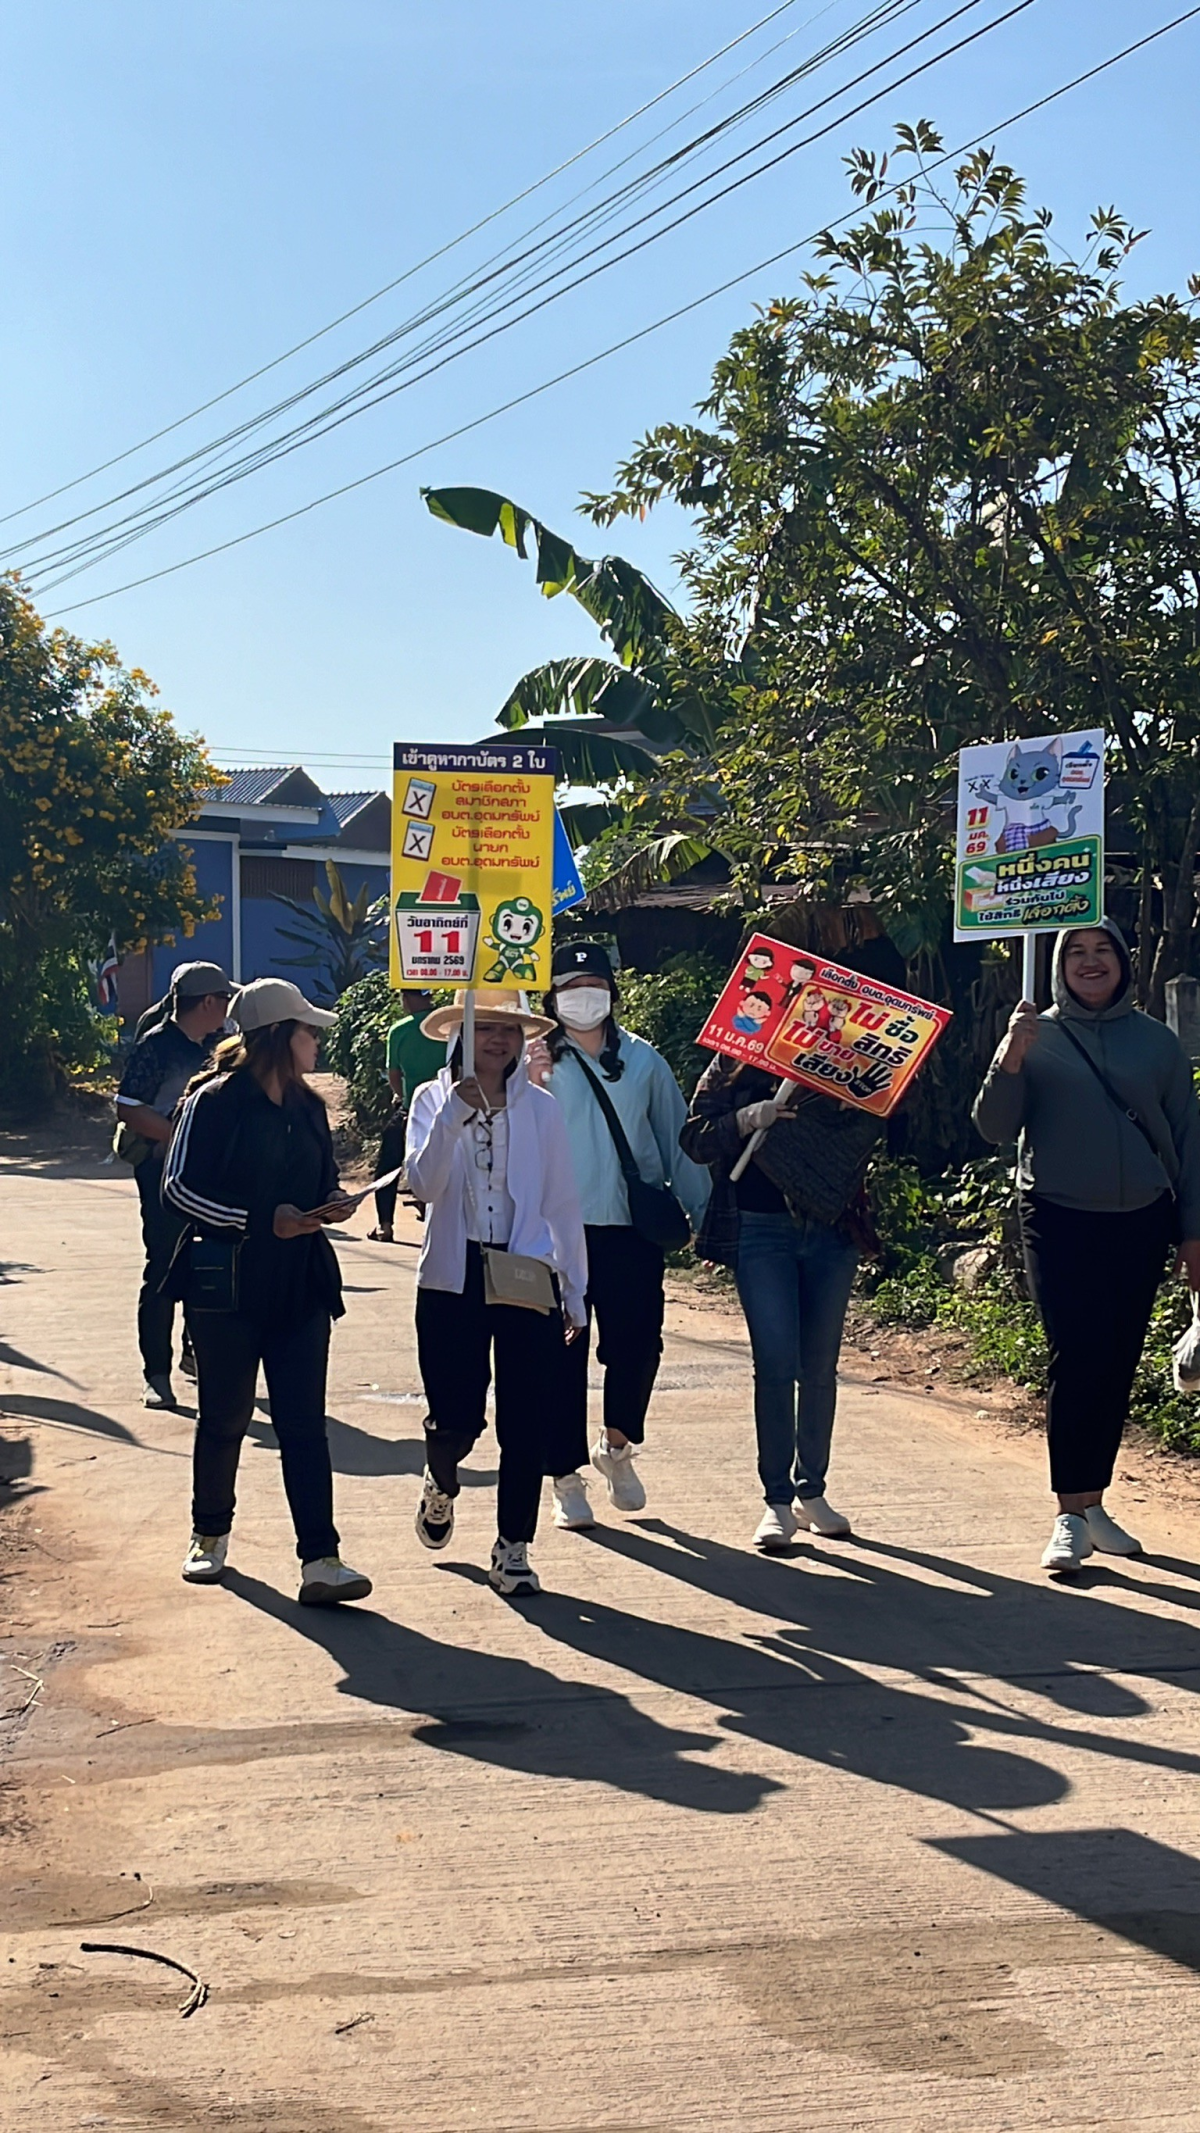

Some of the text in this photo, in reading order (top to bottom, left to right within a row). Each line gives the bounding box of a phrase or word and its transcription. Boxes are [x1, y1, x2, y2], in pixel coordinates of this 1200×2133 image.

[402, 749, 546, 770] เข้าคูหากาบัตร 2 ใบ
[452, 778, 530, 794] บัตรเลือกตั้ง
[455, 795, 526, 807] สมาชิกสภา
[442, 810, 540, 822] อบต.อุดมทรัพย์
[968, 806, 988, 826] 11
[452, 824, 530, 840] บัตรเลือกตั้ง
[473, 843, 508, 852] นายก
[966, 841, 986, 854] 69
[442, 856, 540, 869] อบต.อุดมทรัพย์
[998, 853, 1090, 877] หนึ่งคน
[996, 871, 1090, 893] หนึ่งเสียง
[1006, 891, 1065, 906] ร่วมกันไป
[406, 915, 468, 928] วันอาทิตย์ที่
[444, 956, 464, 964] 2569
[575, 952, 587, 962] P
[821, 968, 934, 1020] เลือกตั้ง อบต.อุดมทรัพย์
[850, 1002, 919, 1044] ไม่ ซื้อ
[708, 1024, 724, 1038] 11
[783, 1020, 856, 1060] ไม่ ขาย
[794, 1052, 852, 1082] เสียง
